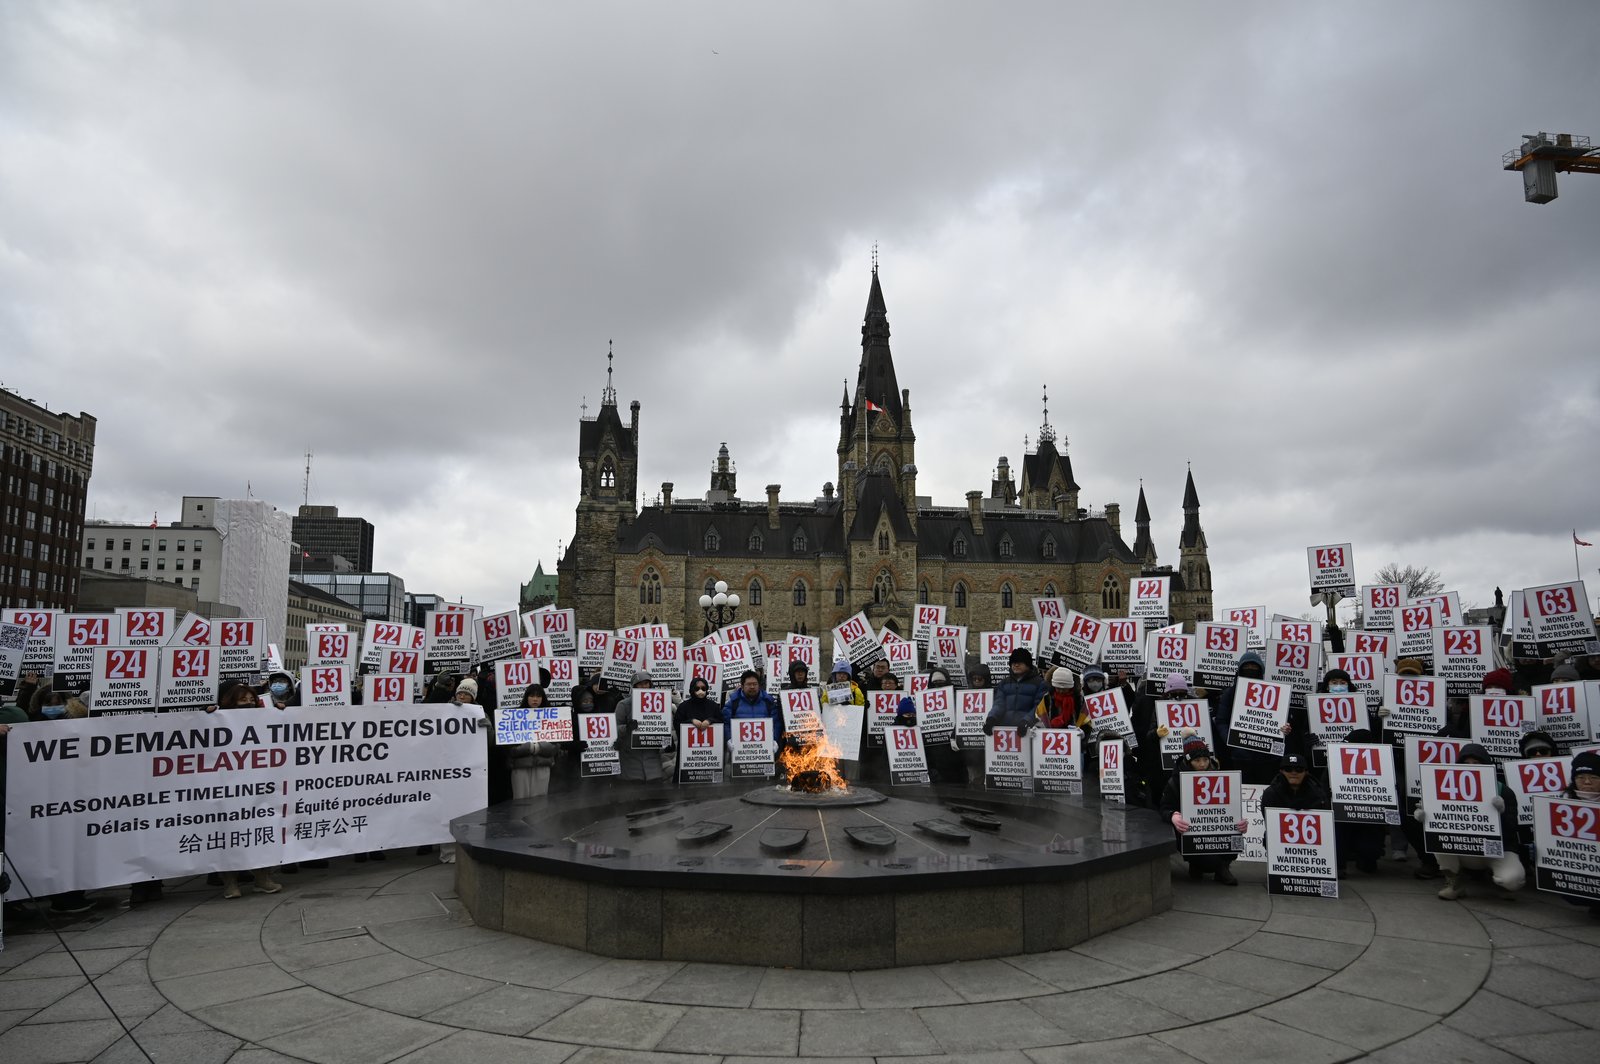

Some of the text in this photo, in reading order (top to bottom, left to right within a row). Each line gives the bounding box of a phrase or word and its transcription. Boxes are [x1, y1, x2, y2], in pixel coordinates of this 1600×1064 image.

[1319, 549, 1342, 567] 43
[1140, 581, 1159, 598] 22
[1374, 589, 1396, 608] 36
[1540, 588, 1572, 615] 63
[130, 612, 160, 636] 23
[438, 614, 460, 636] 11
[545, 614, 565, 633] 20
[921, 608, 938, 623] 42
[1405, 608, 1430, 630] 32
[1546, 615, 1575, 623] MONTHS
[72, 619, 105, 645] 54
[224, 622, 249, 646] 31
[377, 624, 400, 645] 22
[487, 616, 510, 639] 39
[843, 620, 863, 644] 30
[1073, 617, 1096, 641] 13
[1112, 622, 1134, 642] 70
[1284, 625, 1309, 642] 35
[1540, 623, 1569, 632] WAITING
[1554, 628, 1590, 638] RESPONSE
[321, 635, 347, 658] 39
[523, 640, 543, 658] 27
[588, 633, 606, 649] 62
[940, 640, 956, 657] 32
[990, 635, 1012, 654] 39
[1161, 638, 1184, 659] 68
[1210, 628, 1234, 650] 53
[1360, 636, 1385, 652] 37
[1448, 630, 1476, 654] 23
[614, 640, 637, 661] 39
[655, 641, 675, 660] 36
[720, 643, 742, 661] 30
[892, 645, 910, 660] 20
[1279, 645, 1306, 668] 28
[110, 651, 142, 678] 24
[176, 650, 206, 678] 34
[392, 652, 416, 673] 27
[553, 660, 571, 679] 39
[1343, 657, 1370, 679] 40
[314, 668, 339, 693] 53
[507, 663, 530, 684] 40
[377, 678, 402, 701] 19
[1249, 684, 1277, 710] 30
[1400, 680, 1429, 706] 65
[113, 697, 152, 706] RESPONSE
[643, 693, 662, 712] 36
[790, 692, 811, 711] 20
[878, 694, 899, 713] 34
[926, 691, 945, 711] 55
[965, 693, 984, 712] 34
[1089, 694, 1114, 717] 34
[1323, 699, 1351, 722] 90
[1546, 689, 1571, 714] 41
[1171, 704, 1197, 726] 30
[1239, 715, 1279, 727] WAITING FOR
[1247, 709, 1272, 719] MONTHS
[1487, 700, 1520, 726] 40
[589, 718, 608, 738] 39
[691, 728, 711, 747] 11
[742, 722, 763, 741] 35
[1248, 734, 1273, 743] TIMELINES
[1249, 724, 1280, 735] RESPONSE
[23, 718, 477, 762] WE DEMAND A TIMELY DECISION
[897, 730, 917, 749] 51
[997, 731, 1018, 752] 31
[1045, 733, 1068, 755] 23
[1249, 741, 1270, 749] RESULTS
[152, 742, 389, 777] DELAYED BY IRCC
[1105, 745, 1116, 768] 42
[1345, 748, 1376, 775] 71
[1424, 742, 1456, 763] 20
[295, 767, 472, 792] PROCEDURAL FAIRNESS
[1440, 770, 1477, 800] 40
[1524, 763, 1561, 792] 28
[30, 781, 275, 819] REASONABLE TIMELINES
[1197, 777, 1226, 804] 34
[1353, 794, 1392, 802] RESPONSE
[295, 790, 431, 814] Équité procédurale
[1442, 804, 1478, 812] MONTHS
[87, 806, 275, 837] Délais raisonnables
[1434, 813, 1469, 821] WAITING
[1450, 823, 1495, 832] RESPONSE
[1556, 805, 1597, 839] 32
[293, 815, 368, 841] 程序公平
[1284, 814, 1318, 844] 36
[179, 826, 275, 854] 给出时限
[1277, 856, 1308, 865] WAITING
[1290, 866, 1331, 875] RESPONSE
